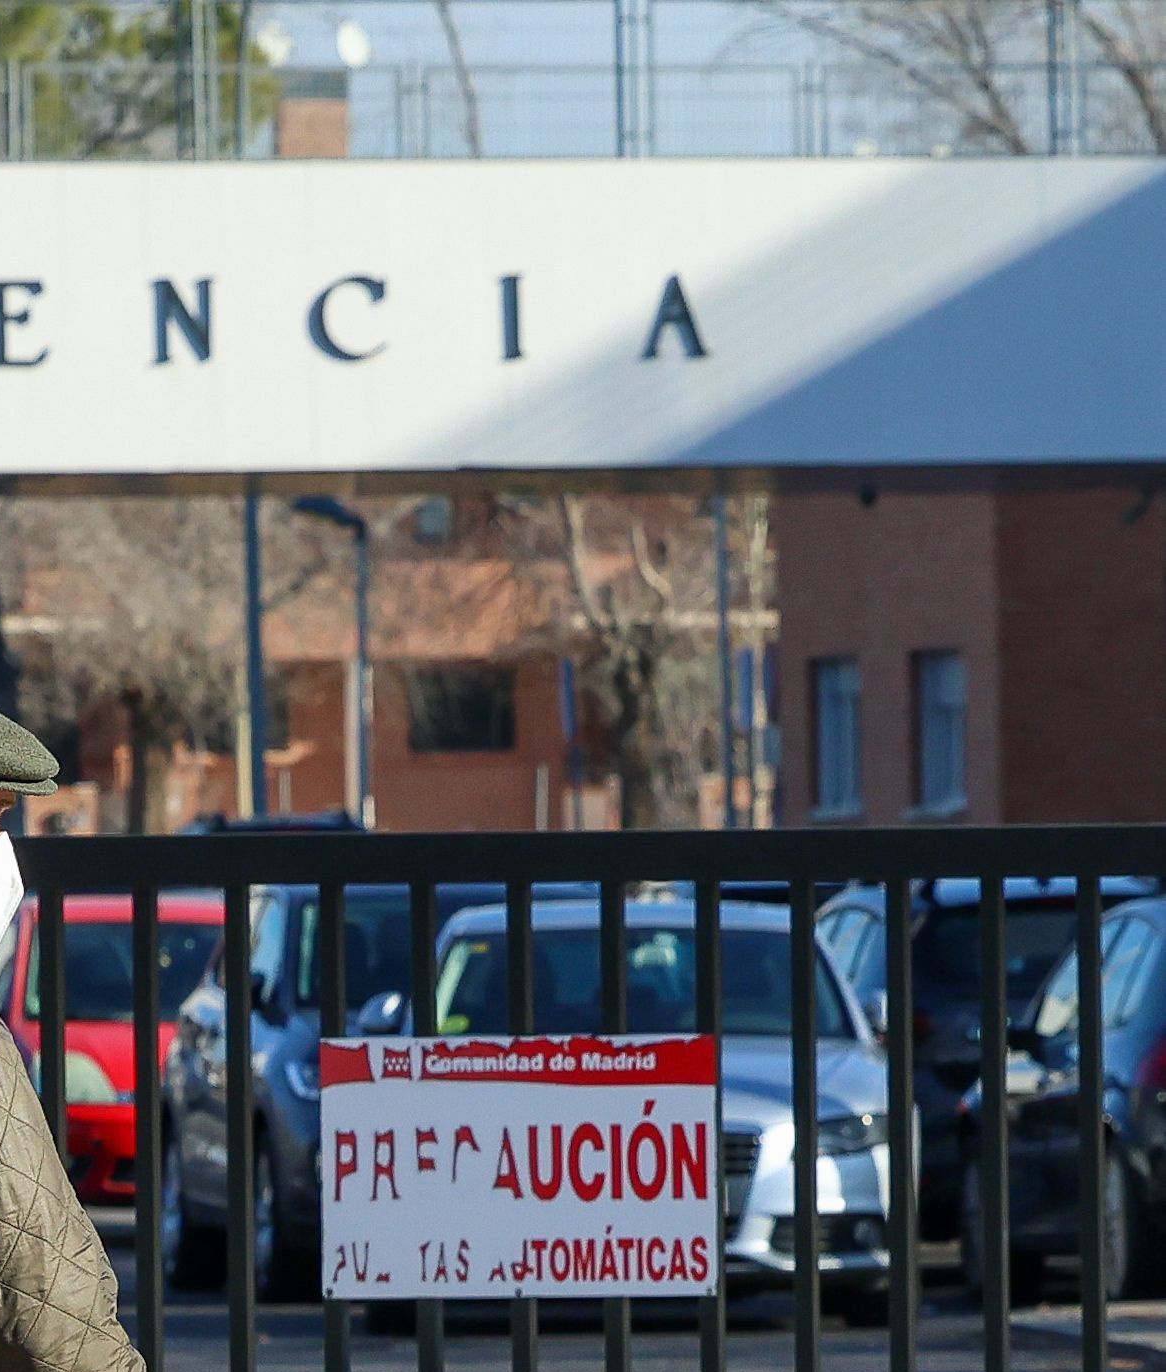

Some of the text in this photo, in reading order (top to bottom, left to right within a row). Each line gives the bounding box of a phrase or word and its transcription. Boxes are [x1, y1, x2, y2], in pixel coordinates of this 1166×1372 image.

[425, 1050, 657, 1073] Comunidad de Madrid
